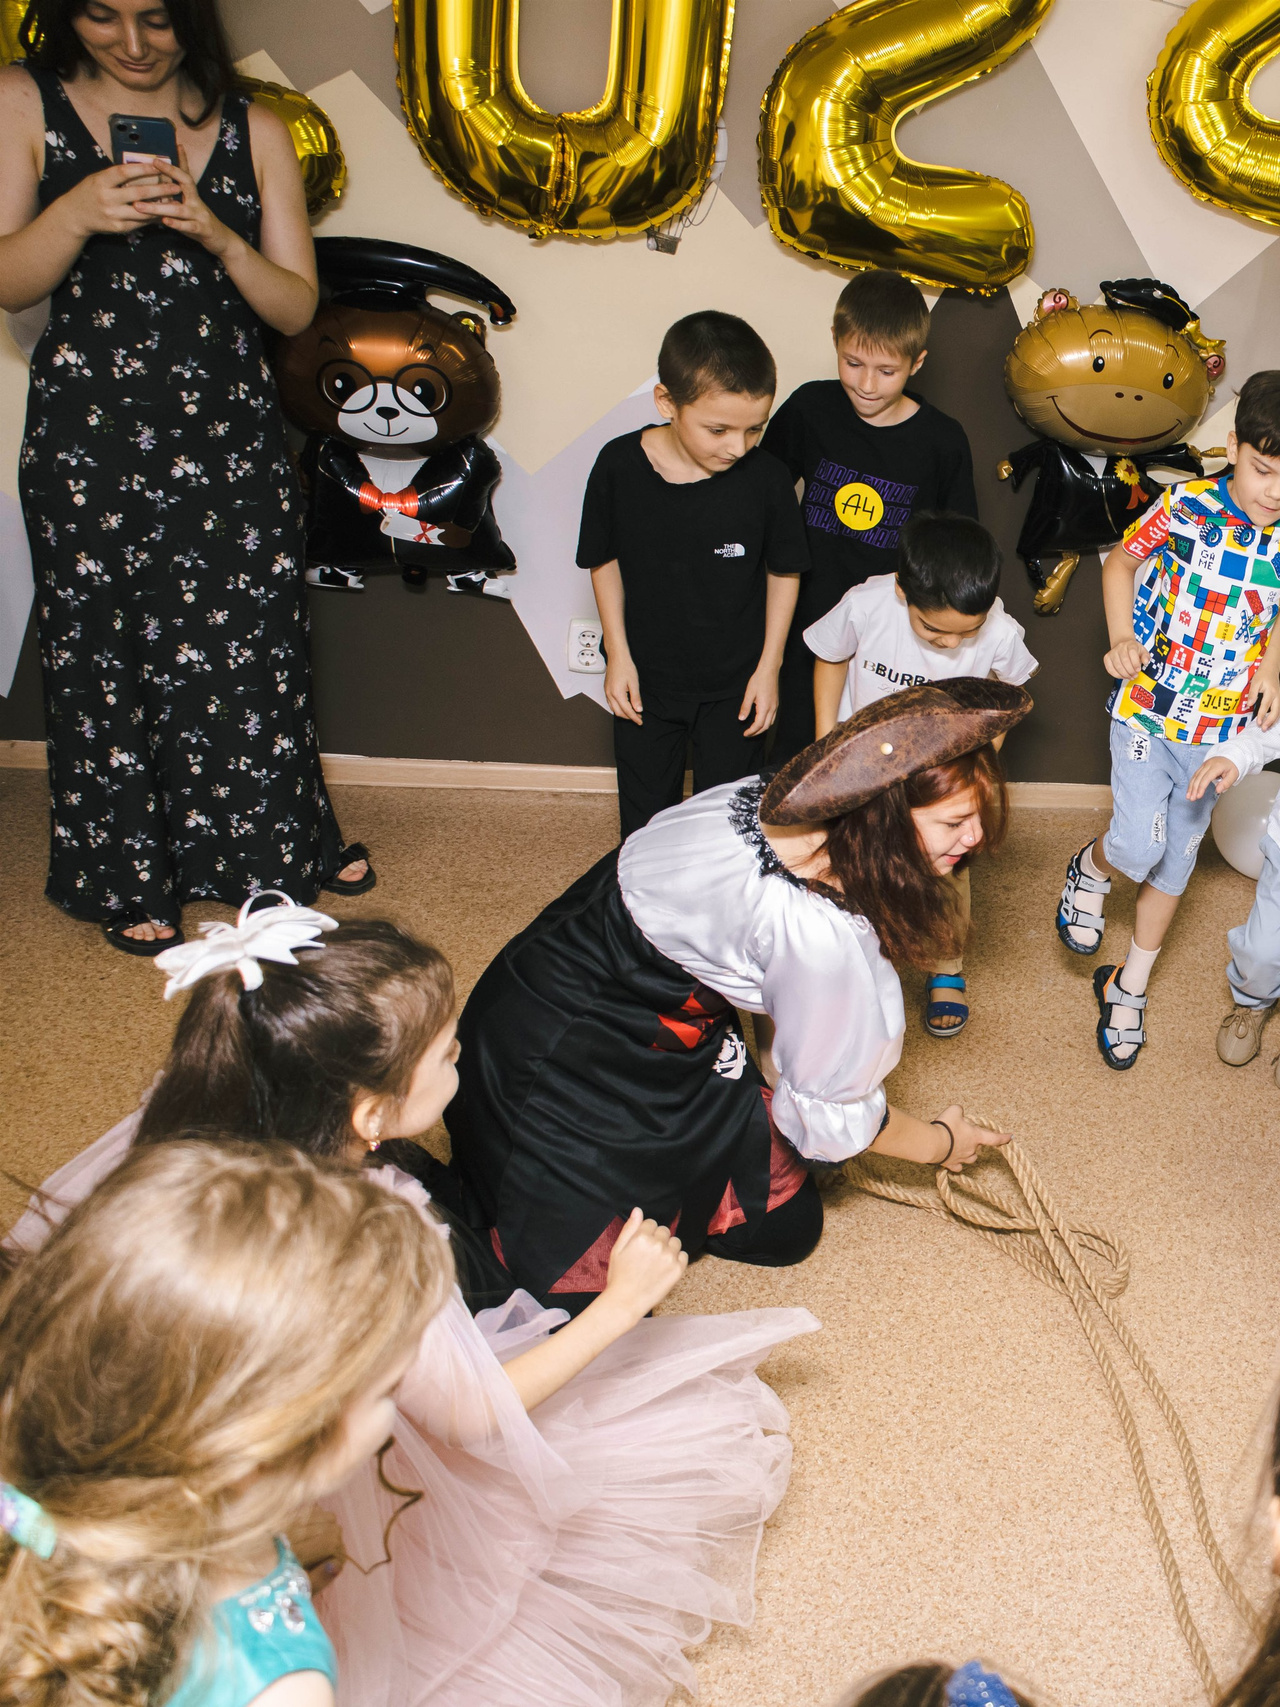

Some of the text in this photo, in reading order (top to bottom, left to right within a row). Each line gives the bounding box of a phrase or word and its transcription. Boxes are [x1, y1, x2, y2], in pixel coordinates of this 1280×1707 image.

[842, 493, 875, 521] A4
[1198, 559, 1214, 570] ME
[875, 662, 935, 686] BURB
